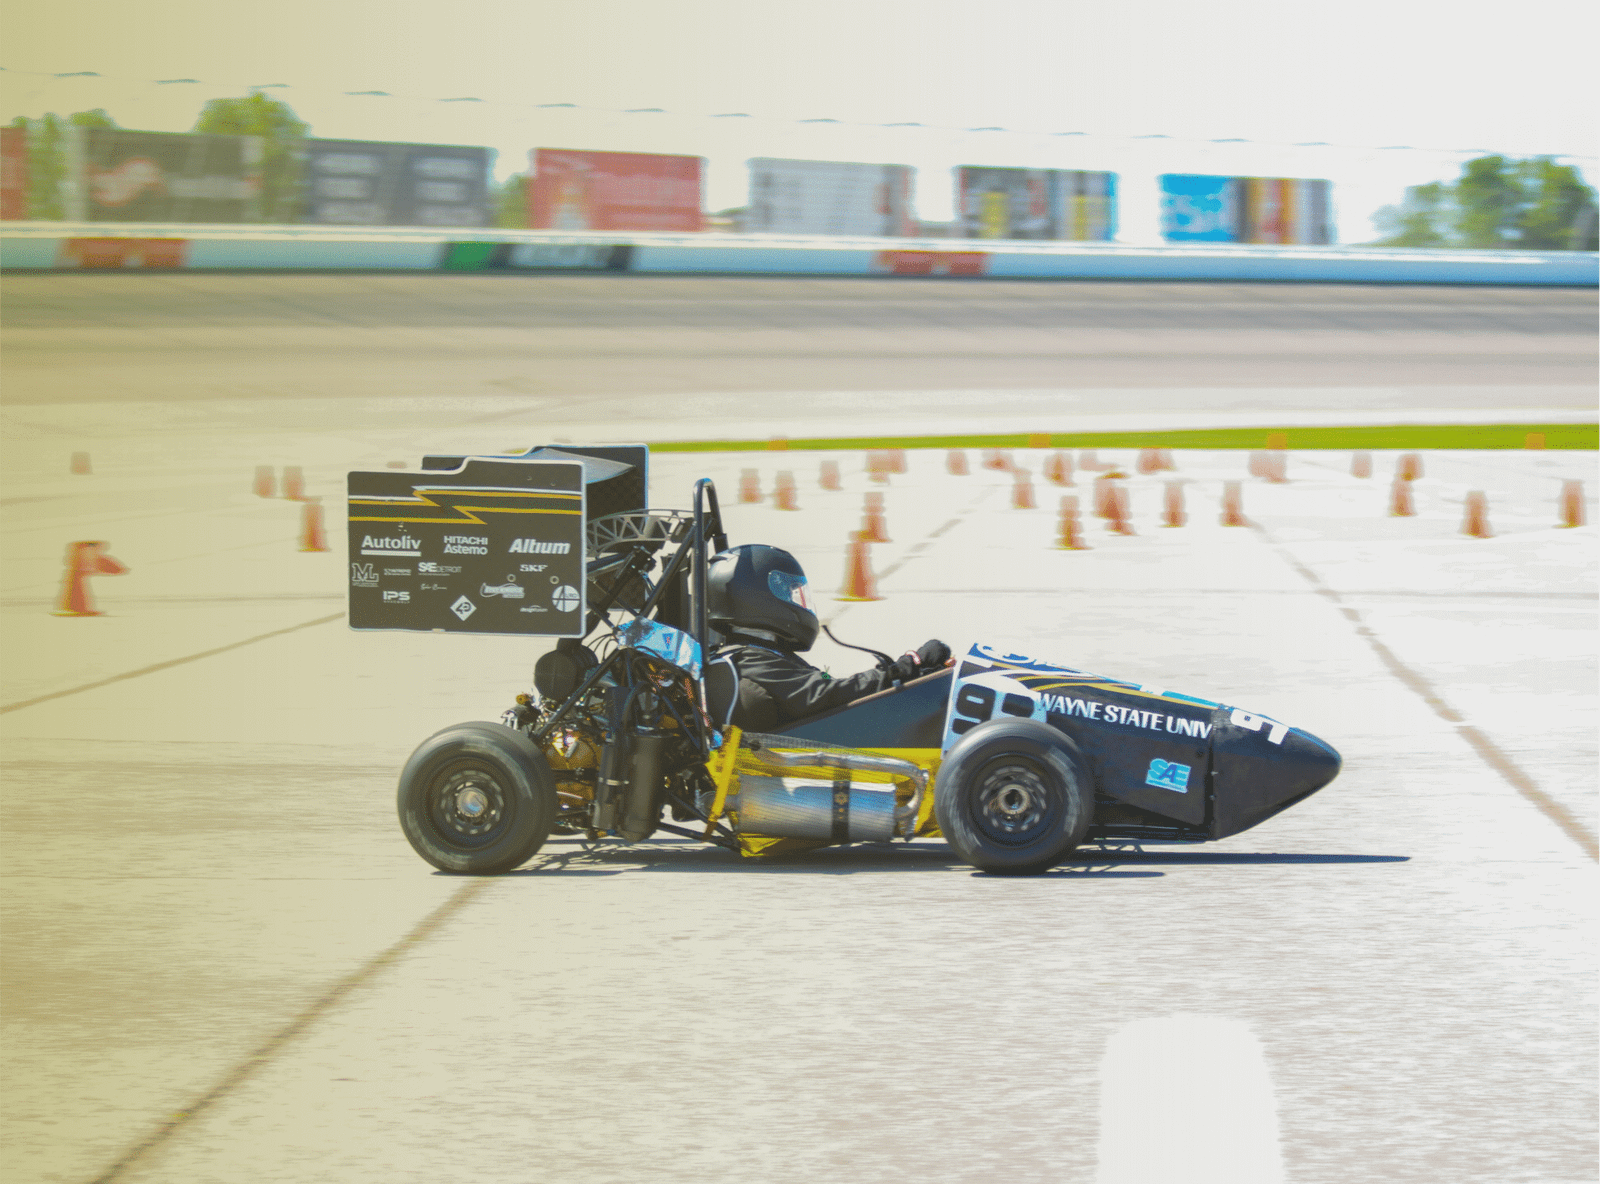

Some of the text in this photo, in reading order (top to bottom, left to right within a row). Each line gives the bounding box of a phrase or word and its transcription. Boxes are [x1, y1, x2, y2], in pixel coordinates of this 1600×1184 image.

[361, 535, 421, 550] Autoliv
[443, 535, 488, 545] HITACHI
[508, 538, 571, 555] Altium
[443, 544, 488, 556] Astemo
[520, 564, 548, 572] SKF
[383, 591, 410, 601] IPS
[1040, 693, 1213, 740] WAYNE STATE UNIV
[1147, 758, 1191, 787] SAE
